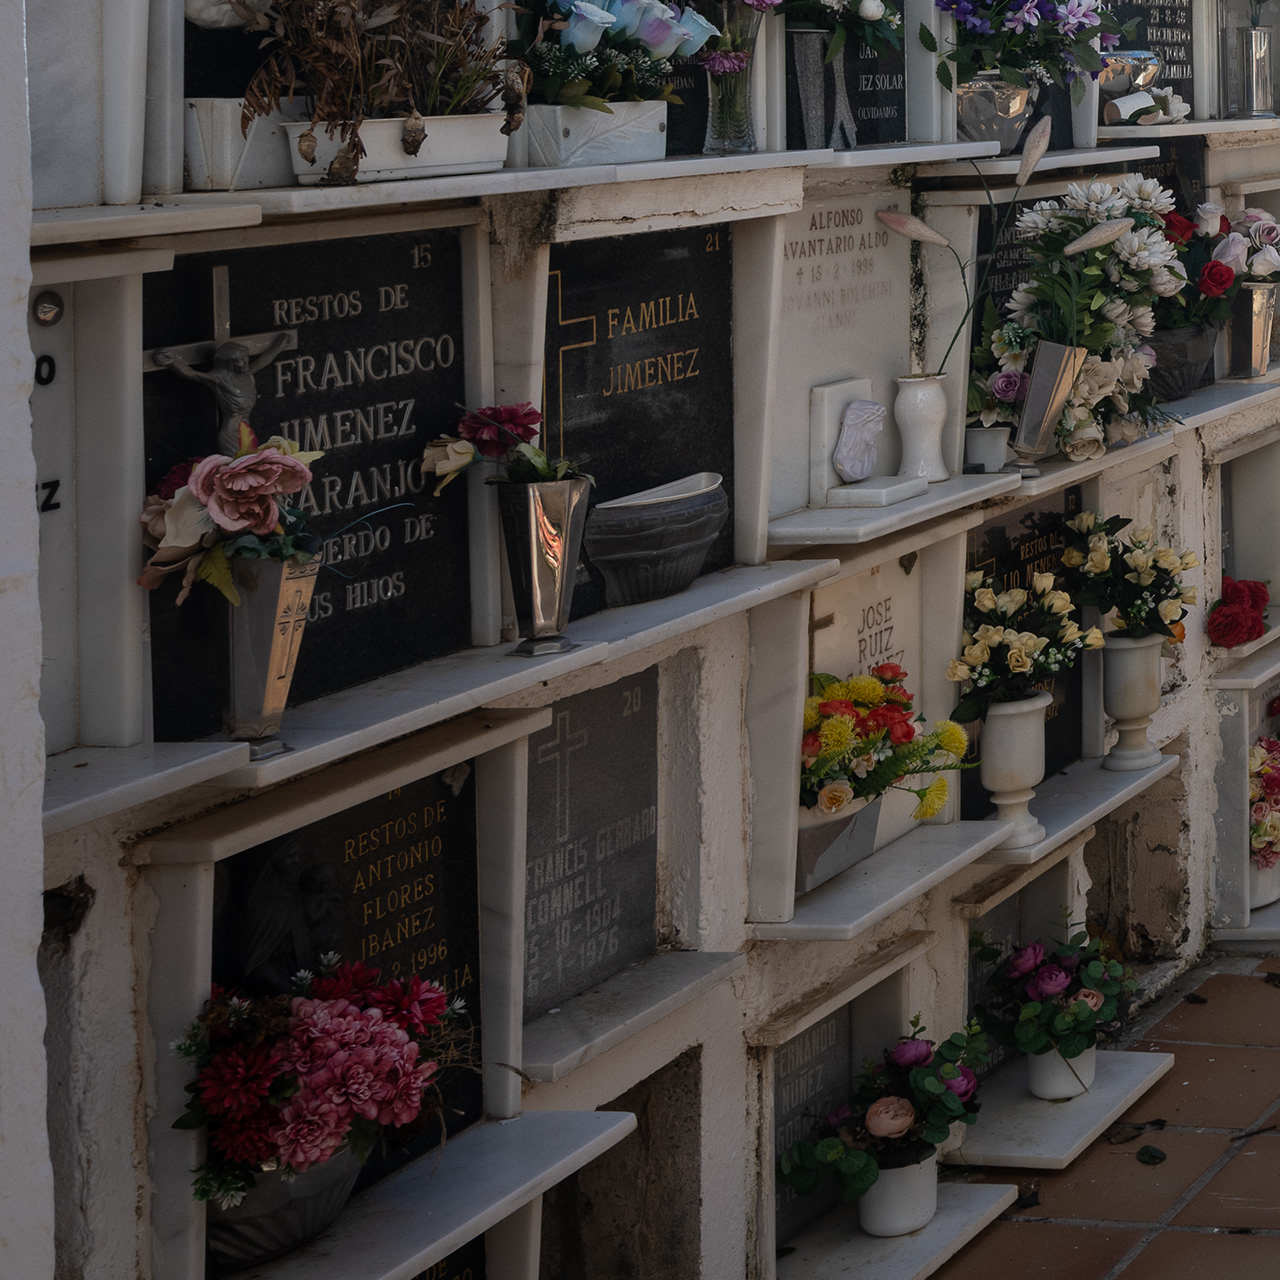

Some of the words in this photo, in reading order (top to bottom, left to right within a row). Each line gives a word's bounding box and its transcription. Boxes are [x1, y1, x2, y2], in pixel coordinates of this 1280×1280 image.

[875, 74, 904, 90] SOLAR
[809, 208, 864, 231] ALFONSO
[410, 243, 432, 269] 15
[705, 232, 721, 253] 21
[859, 231, 889, 251] ALDO
[272, 290, 363, 326] RESTOS
[378, 283, 410, 313] DE
[607, 292, 700, 340] FAMILIA
[275, 333, 456, 399] FRANCISCO
[602, 347, 700, 397] JIMENEZ
[279, 398, 417, 455] JIMENEZ
[286, 458, 426, 520] ARANJO
[404, 513, 435, 545] DE
[345, 572, 406, 612] HIJOS
[857, 596, 893, 636] JOSE
[857, 625, 894, 664] RUIZ
[622, 686, 643, 718] 20
[343, 812, 417, 864] RESTOS
[423, 799, 448, 830] DE
[352, 835, 443, 894] ANTONIO
[363, 873, 436, 927] FLORES
[360, 905, 437, 962] IBAÑEZ
